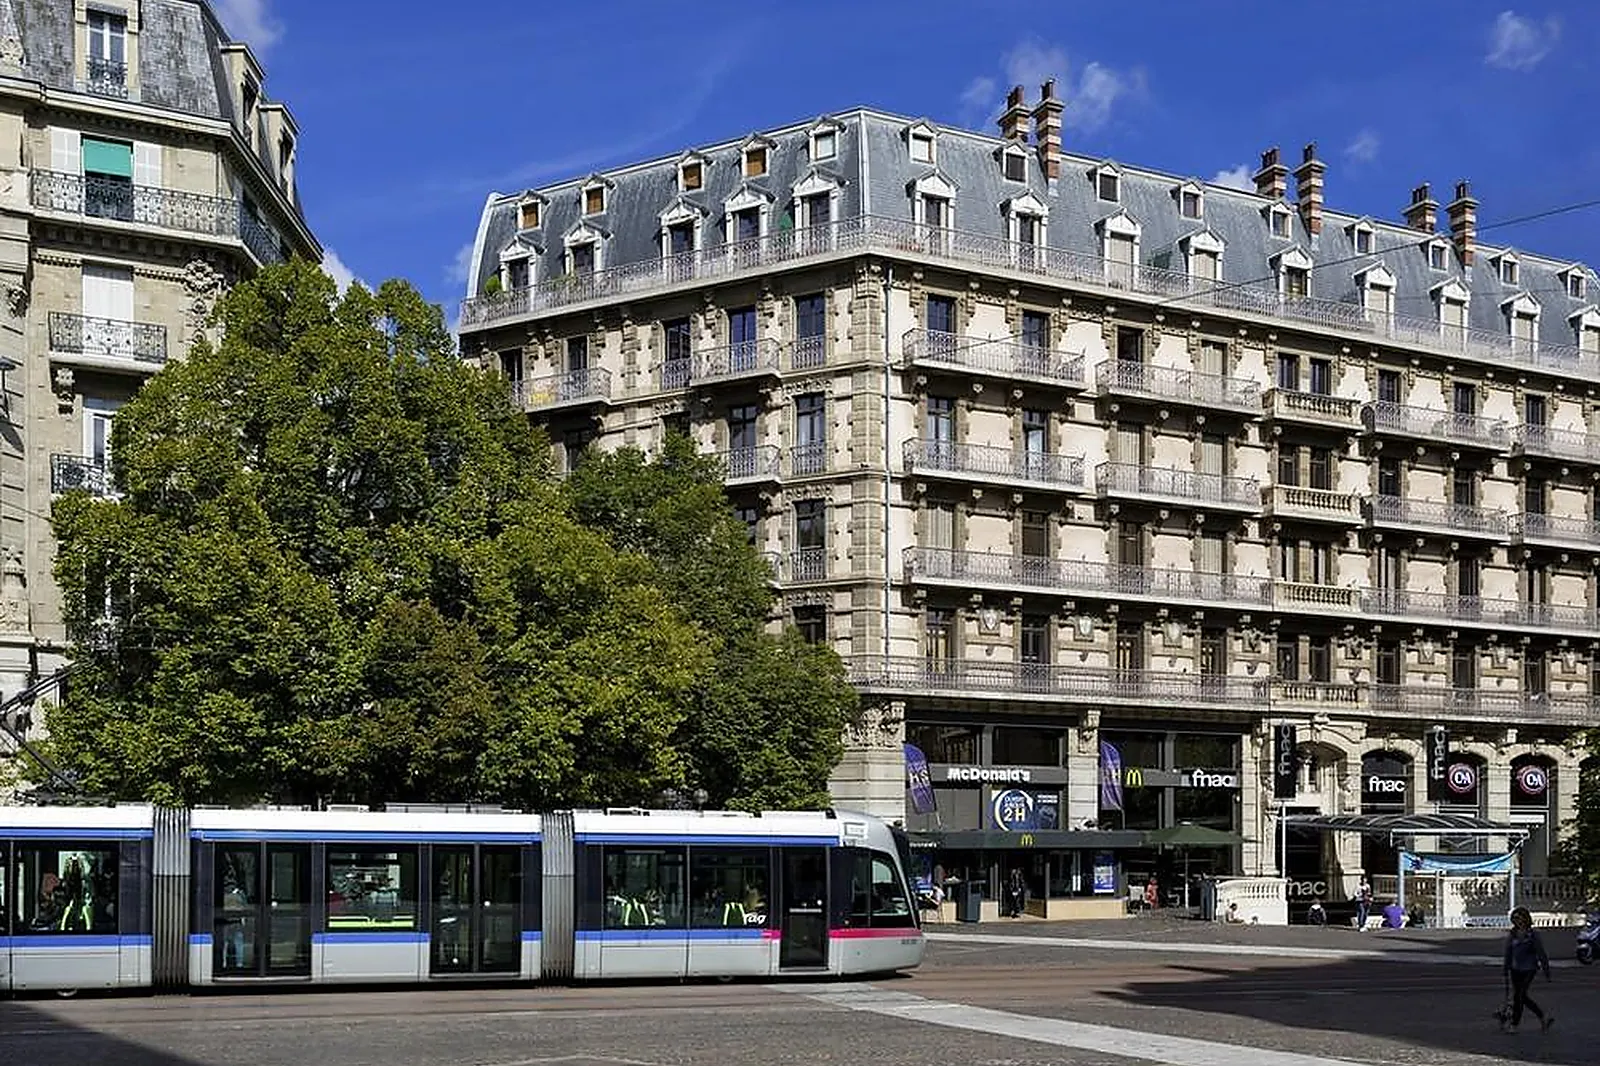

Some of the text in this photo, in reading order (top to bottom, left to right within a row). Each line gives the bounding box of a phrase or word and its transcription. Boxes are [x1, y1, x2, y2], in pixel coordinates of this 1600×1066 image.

[1277, 720, 1291, 776] fnac
[1431, 730, 1446, 779] fnac
[947, 767, 1030, 781] McDonald's
[1192, 769, 1233, 787] fnac
[1368, 776, 1406, 792] fnac
